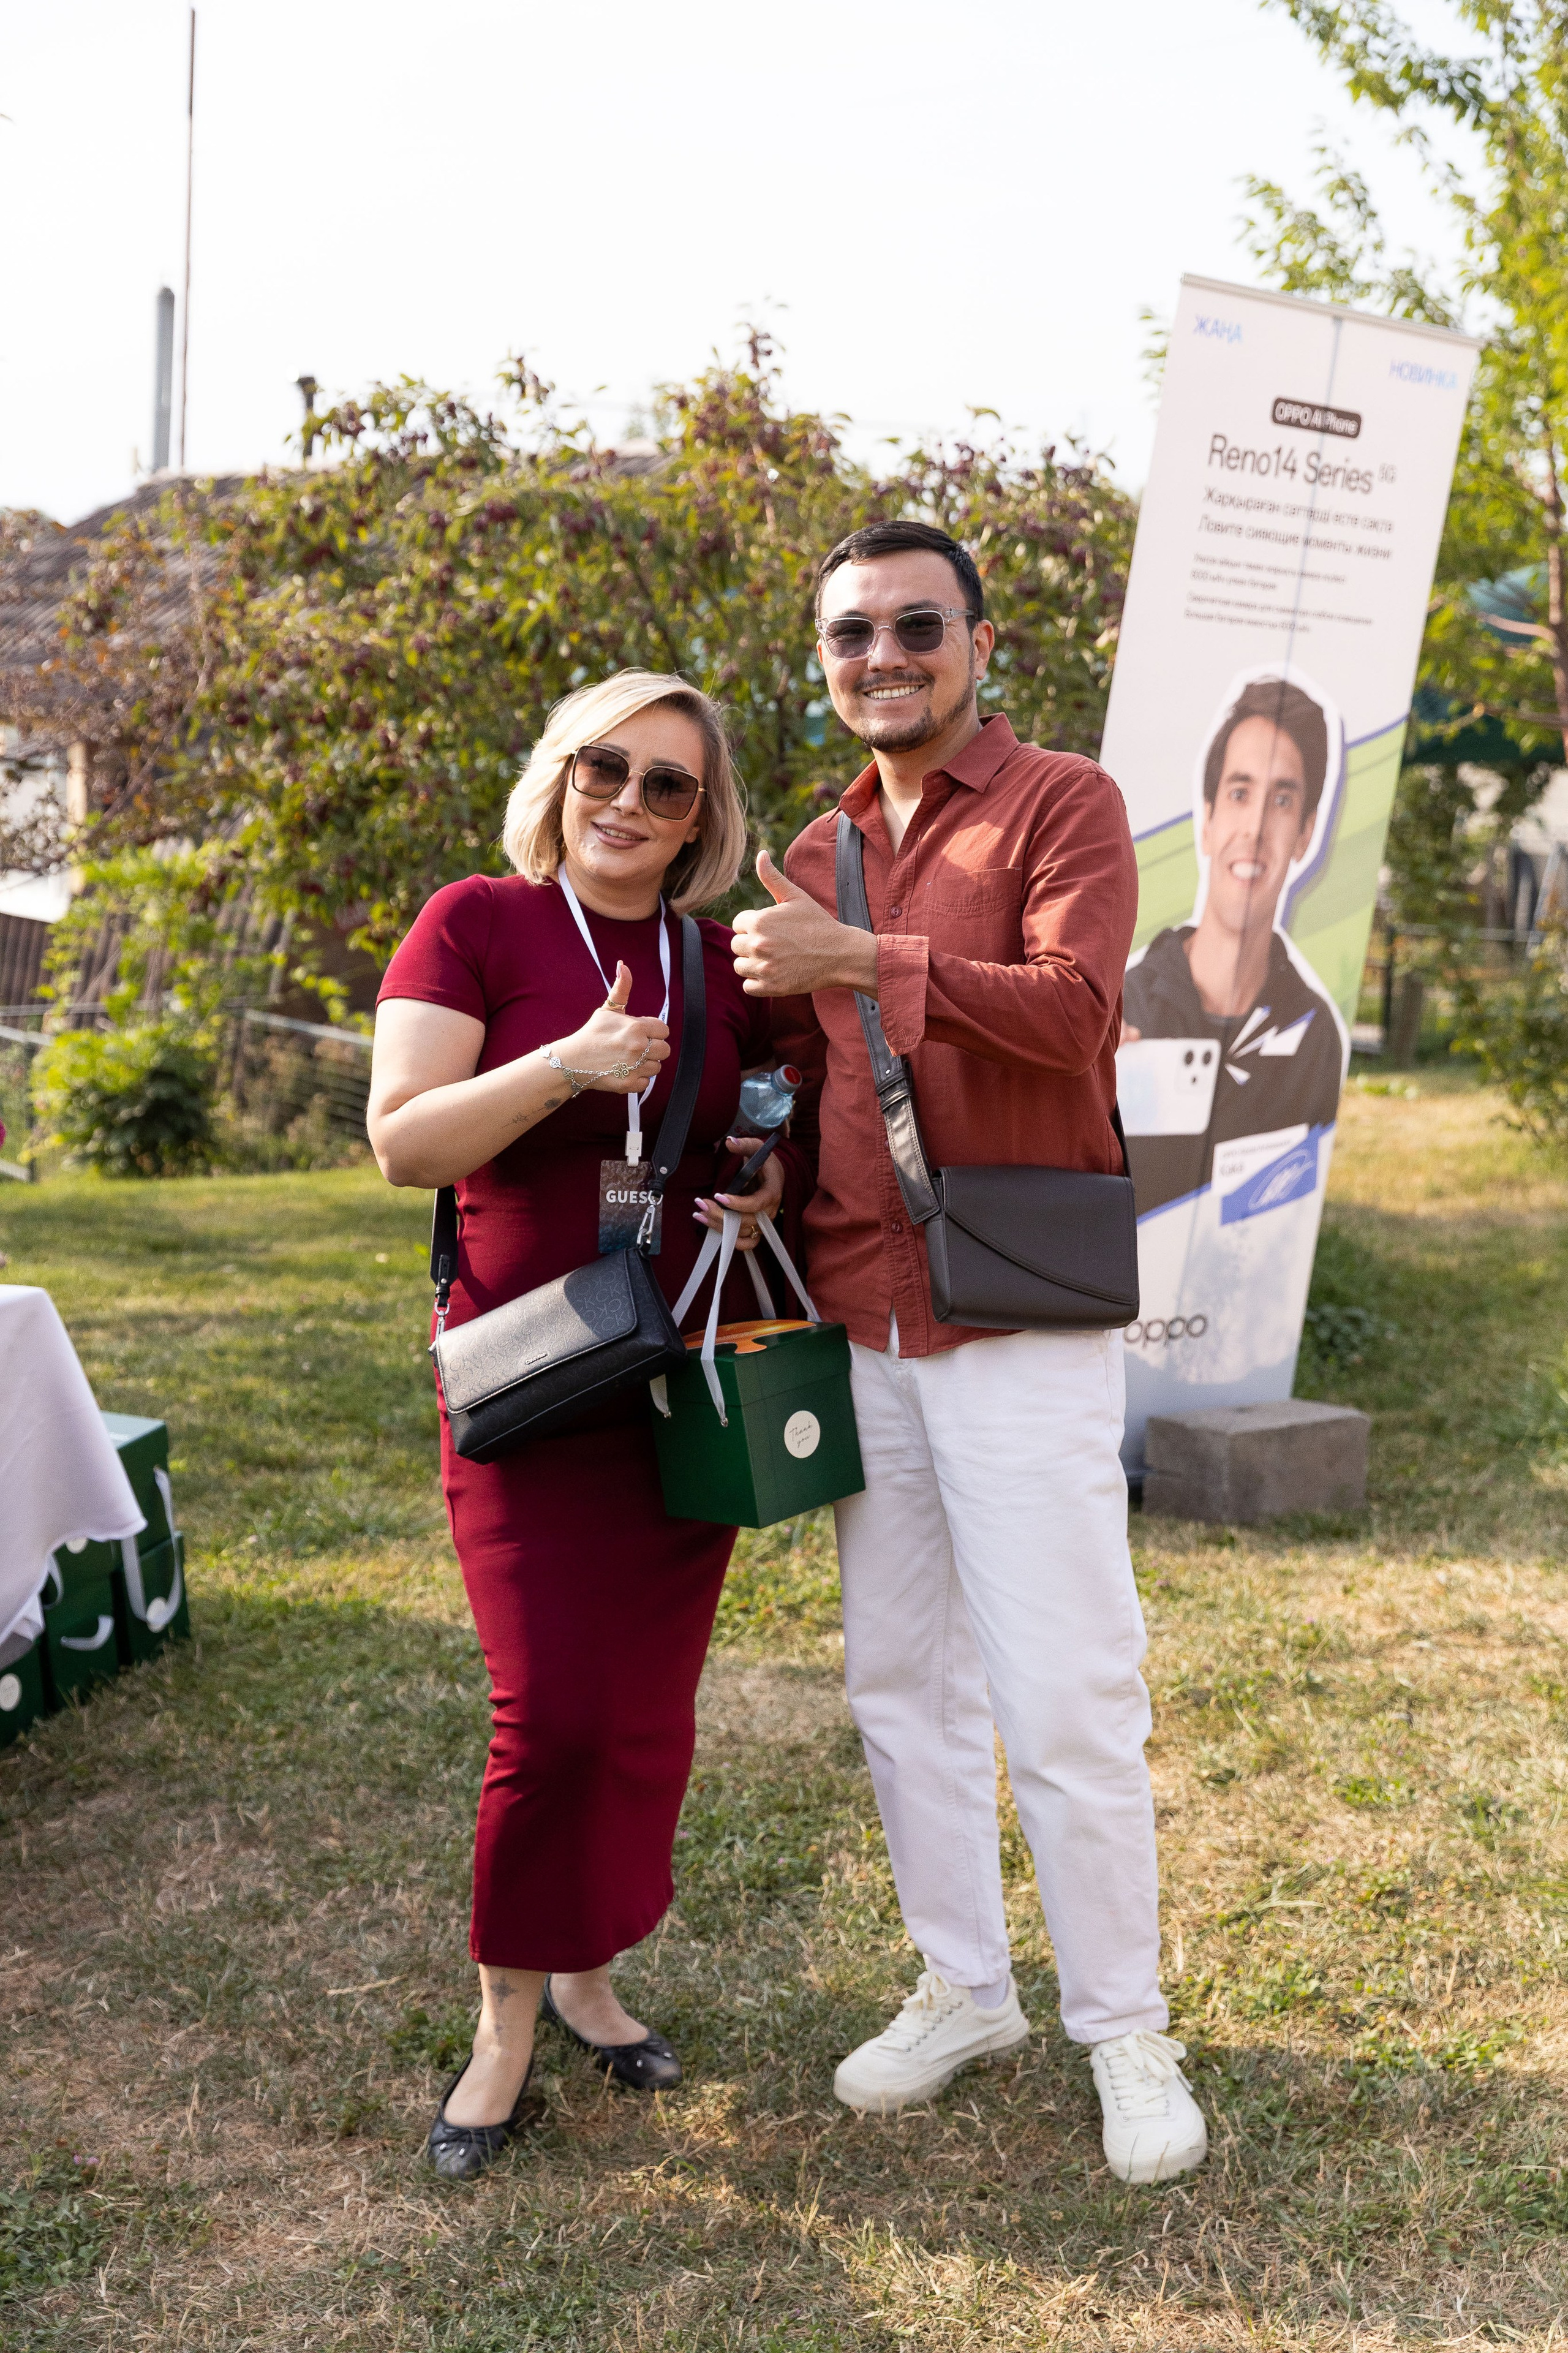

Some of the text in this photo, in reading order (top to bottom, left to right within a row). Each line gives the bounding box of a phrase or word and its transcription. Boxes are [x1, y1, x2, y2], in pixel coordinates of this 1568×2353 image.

[1389, 359, 1457, 388] НОВИНКА
[1275, 401, 1313, 426] OPPO
[1208, 434, 1297, 480] Reno14
[1304, 451, 1373, 494] Series
[606, 1190, 650, 1204] GUES
[1123, 1315, 1209, 1350] oppo
